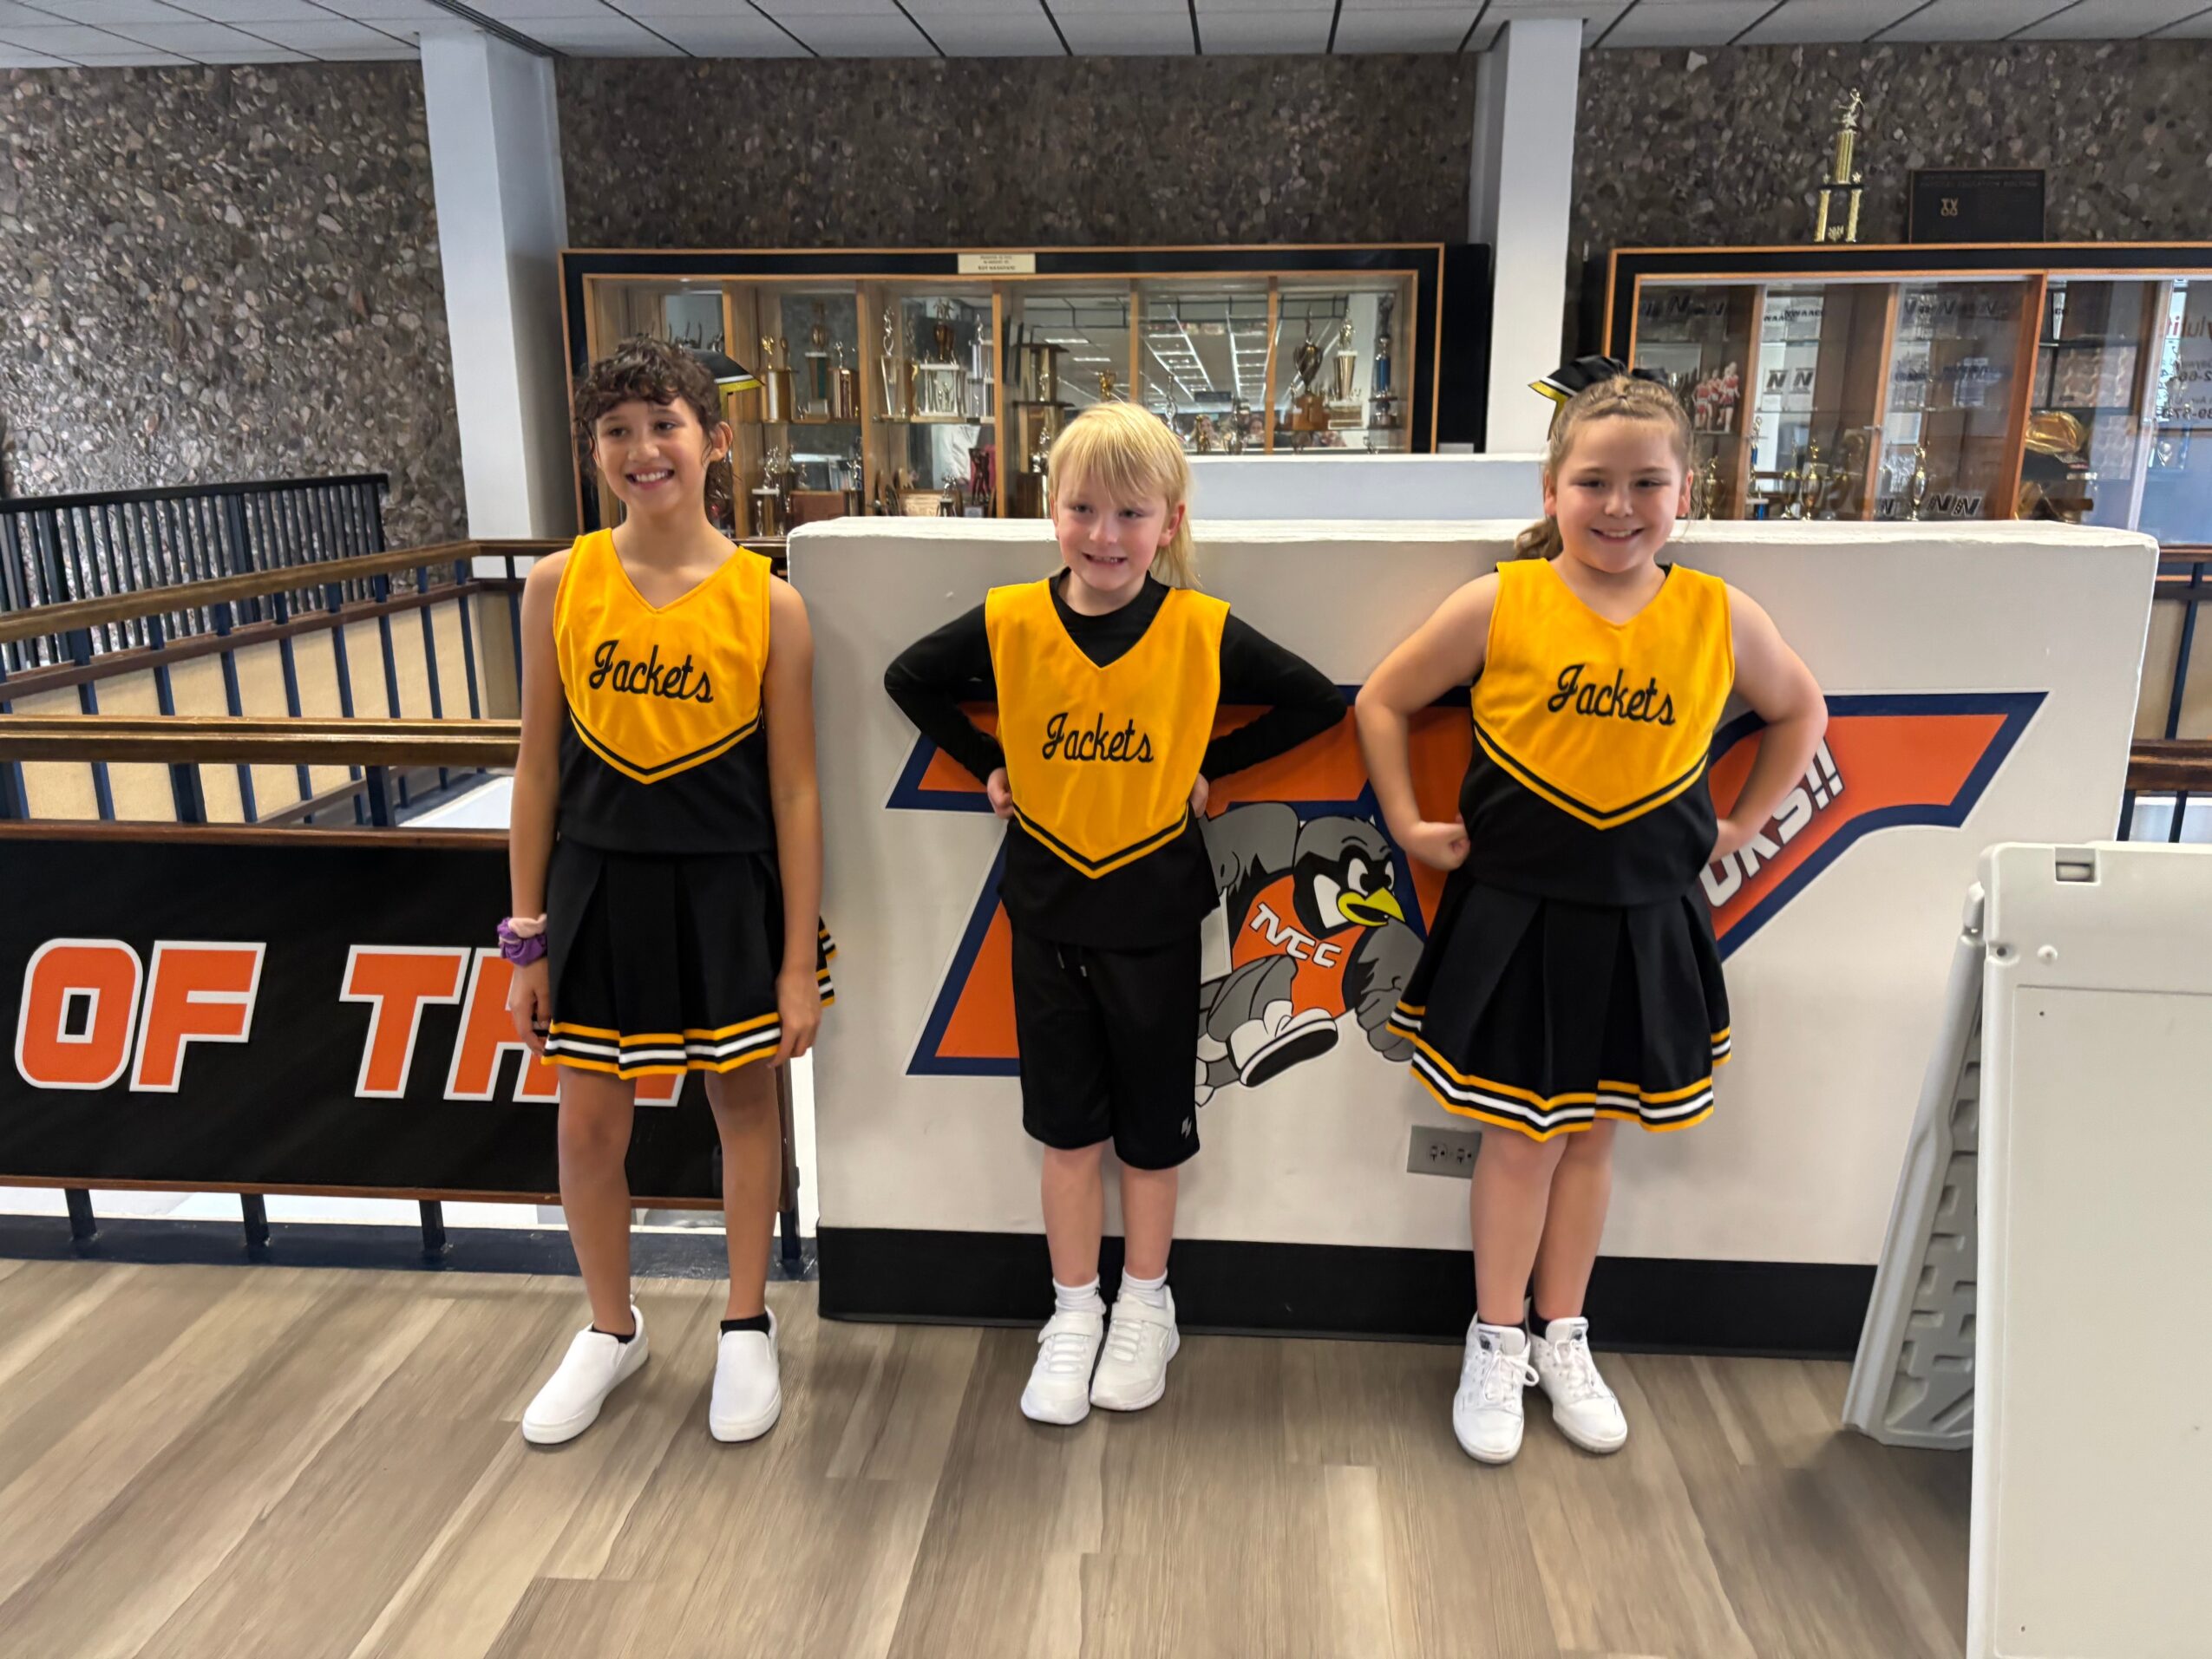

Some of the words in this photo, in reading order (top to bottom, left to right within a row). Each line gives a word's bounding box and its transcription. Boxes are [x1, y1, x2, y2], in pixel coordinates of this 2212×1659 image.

[589, 639, 715, 703] Jackets
[1548, 663, 1677, 726] Jackets
[1042, 712, 1154, 763] Jackets
[1249, 901, 1343, 969] TVCC
[15, 937, 267, 1094] OF
